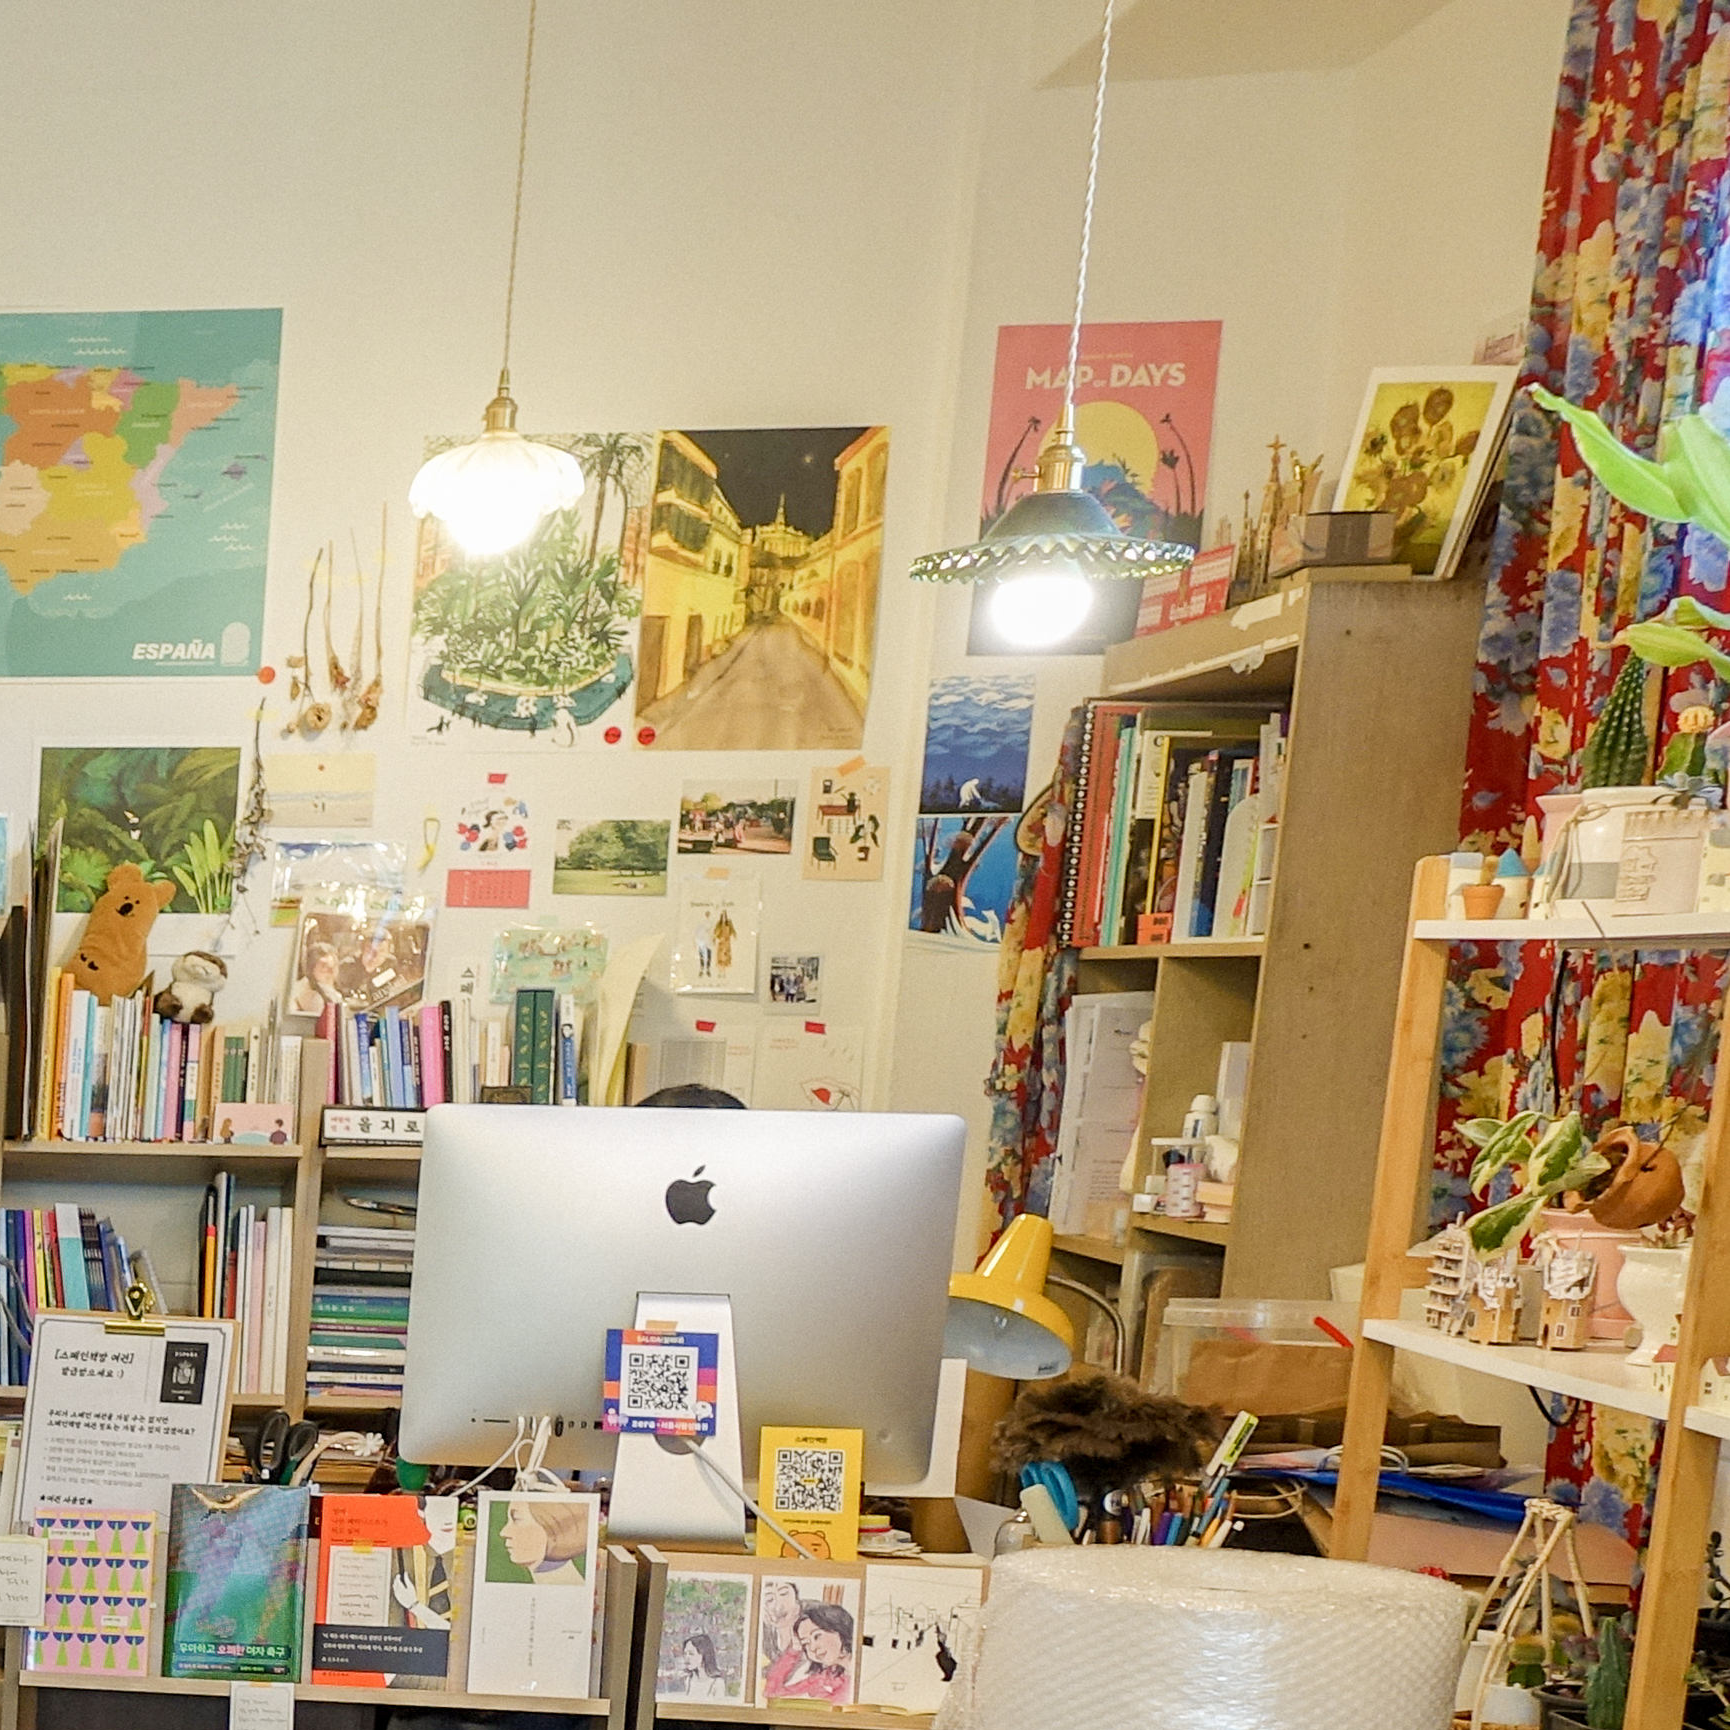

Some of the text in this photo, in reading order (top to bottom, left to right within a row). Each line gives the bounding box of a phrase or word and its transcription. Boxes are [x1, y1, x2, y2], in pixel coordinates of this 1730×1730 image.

[1024, 366, 1093, 390] MAP
[1110, 362, 1186, 388] DAYS
[132, 639, 216, 661] ESPAÑA
